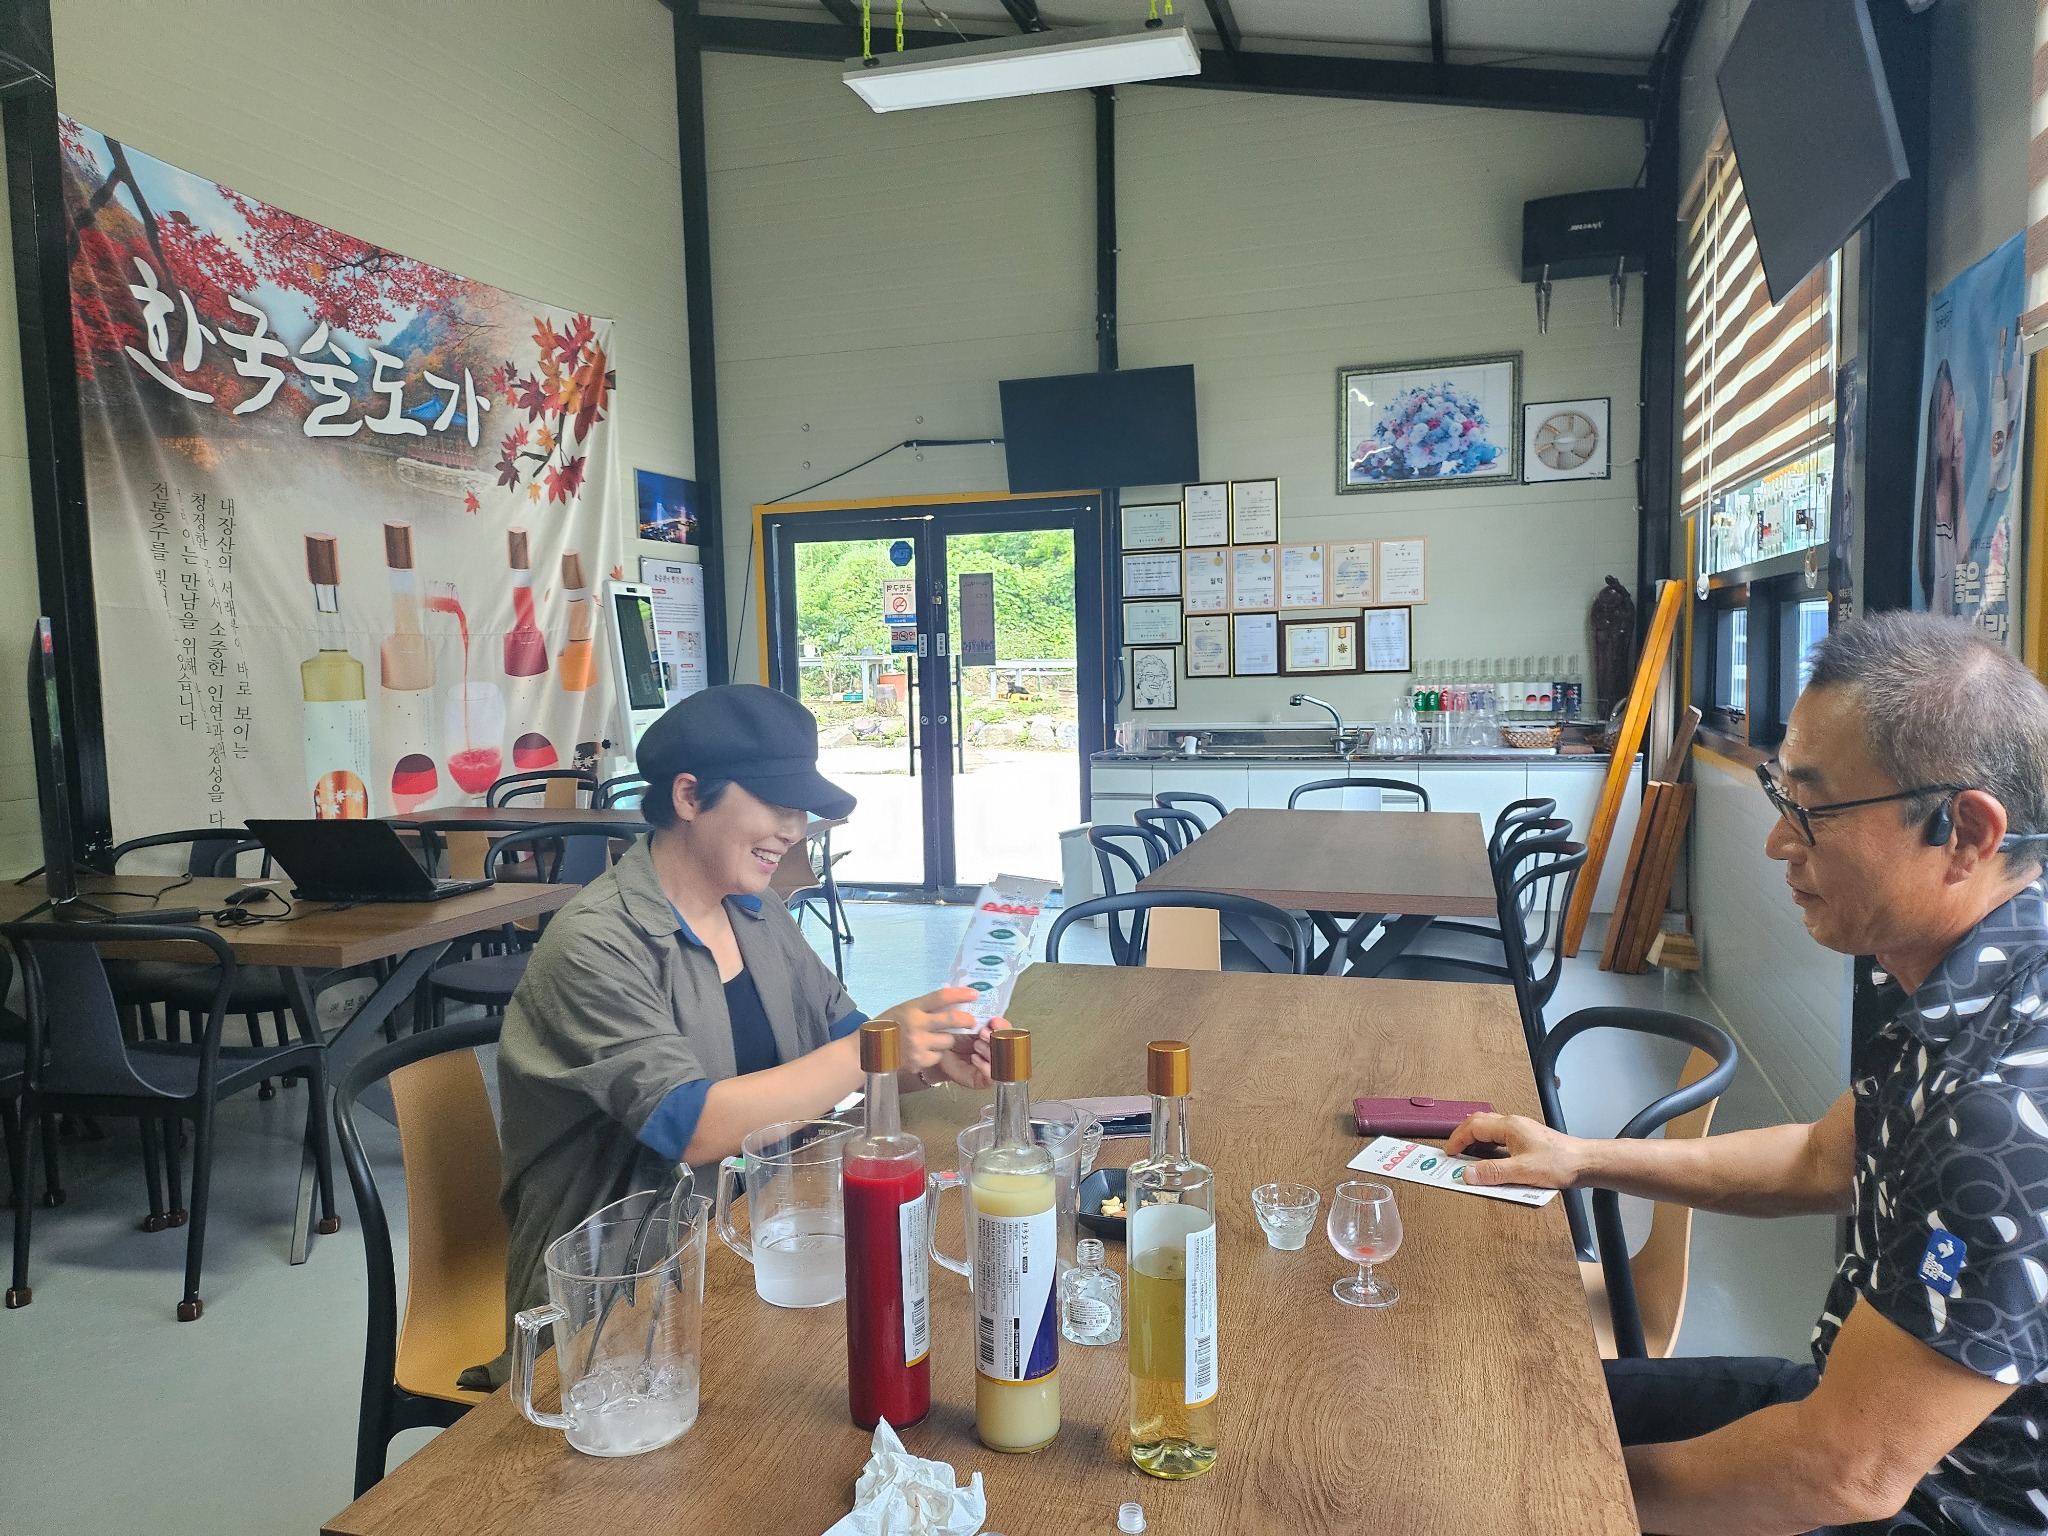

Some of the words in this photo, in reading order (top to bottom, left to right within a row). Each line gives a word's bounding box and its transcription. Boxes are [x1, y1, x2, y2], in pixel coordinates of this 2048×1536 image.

[125, 257, 491, 447] 한국술도가
[149, 481, 171, 562] 전통주를
[191, 493, 209, 551] 청정한
[216, 498, 237, 574] 내장산의
[893, 549, 910, 559] ADT
[179, 572, 200, 630] 만남을
[182, 637, 198, 676] 위해
[206, 621, 228, 677] 소중한
[236, 661, 253, 696] 바로
[207, 684, 225, 741] 인연과
[233, 706, 253, 760] 보이는
[207, 743, 225, 803] 정성을
